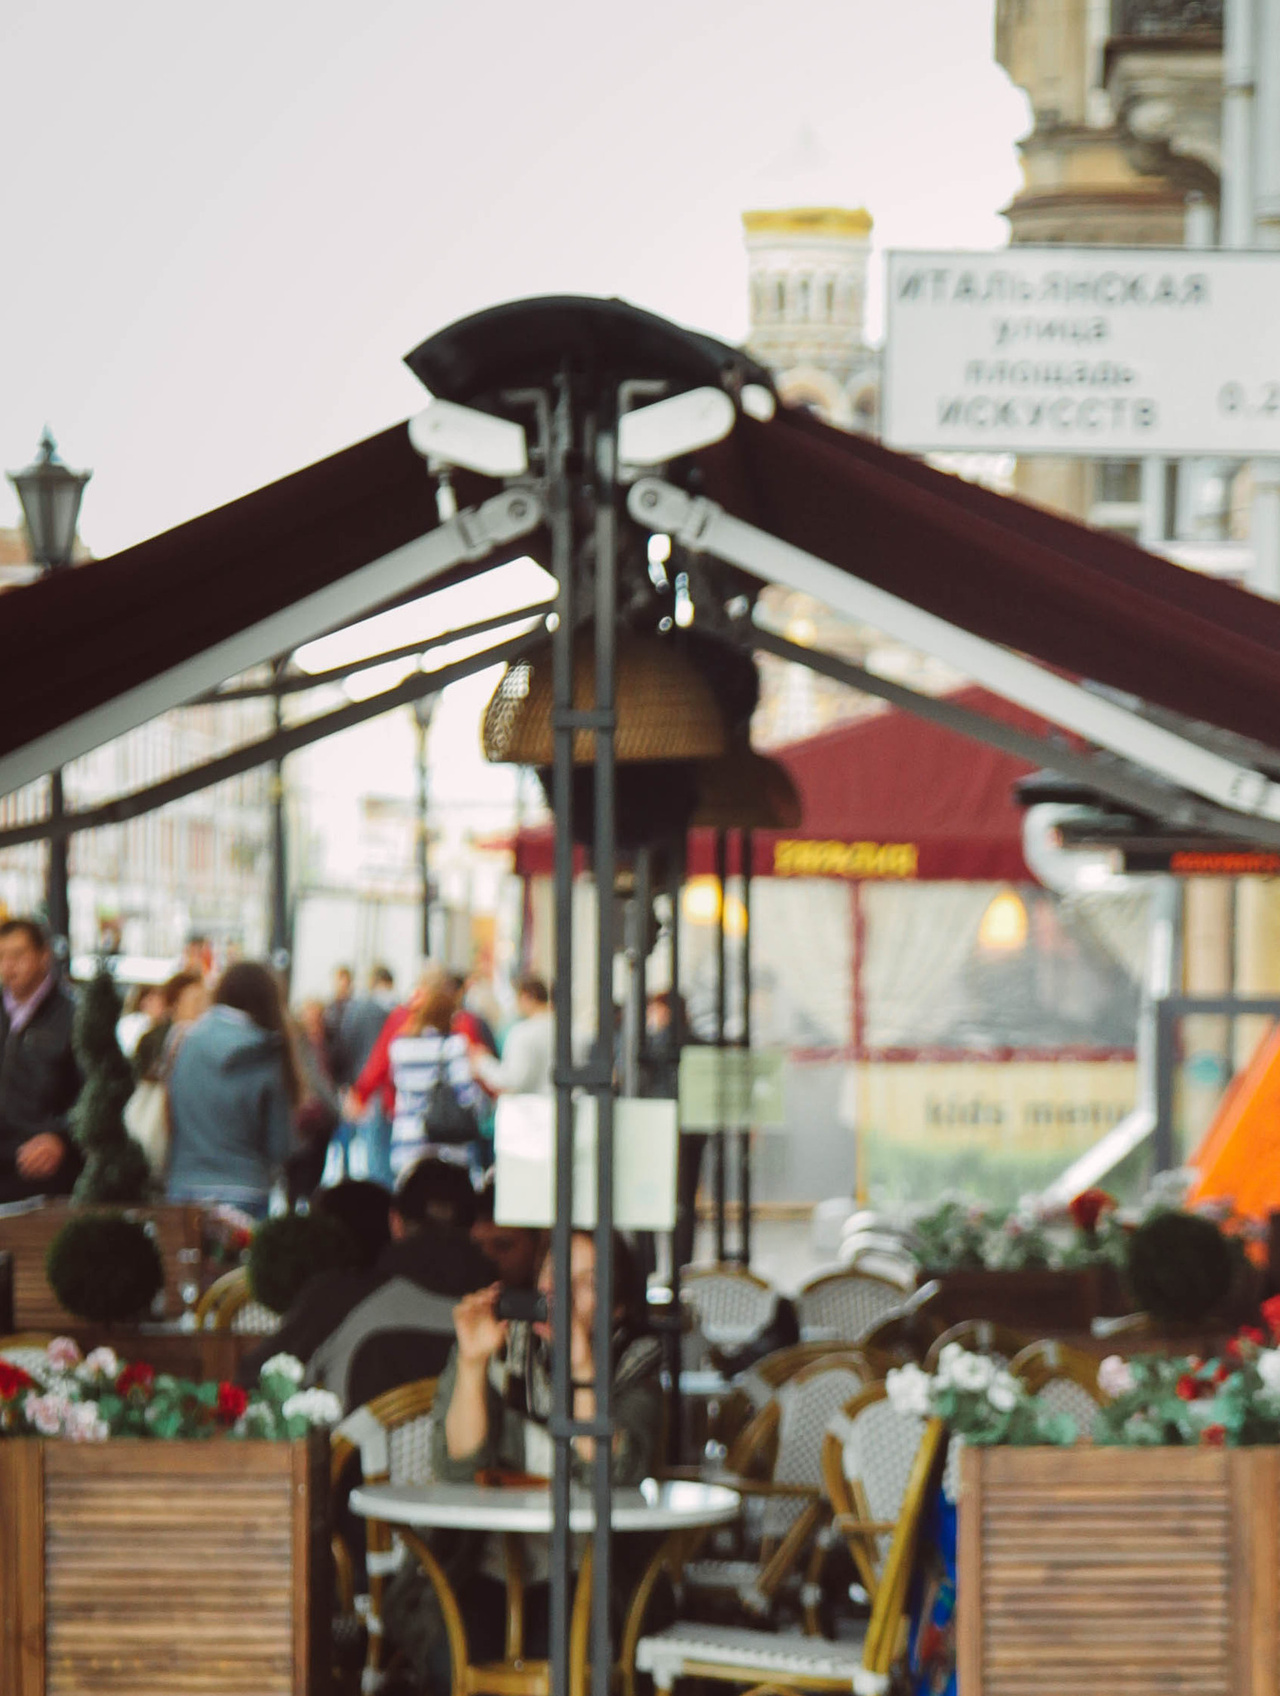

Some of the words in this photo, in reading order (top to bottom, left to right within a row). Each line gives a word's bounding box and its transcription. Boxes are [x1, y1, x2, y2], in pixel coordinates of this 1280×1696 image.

[898, 269, 1210, 304] ИТАЛЬЯНСКАЯ
[992, 316, 1109, 347] улица
[937, 396, 1160, 430] ИСКУССТВ
